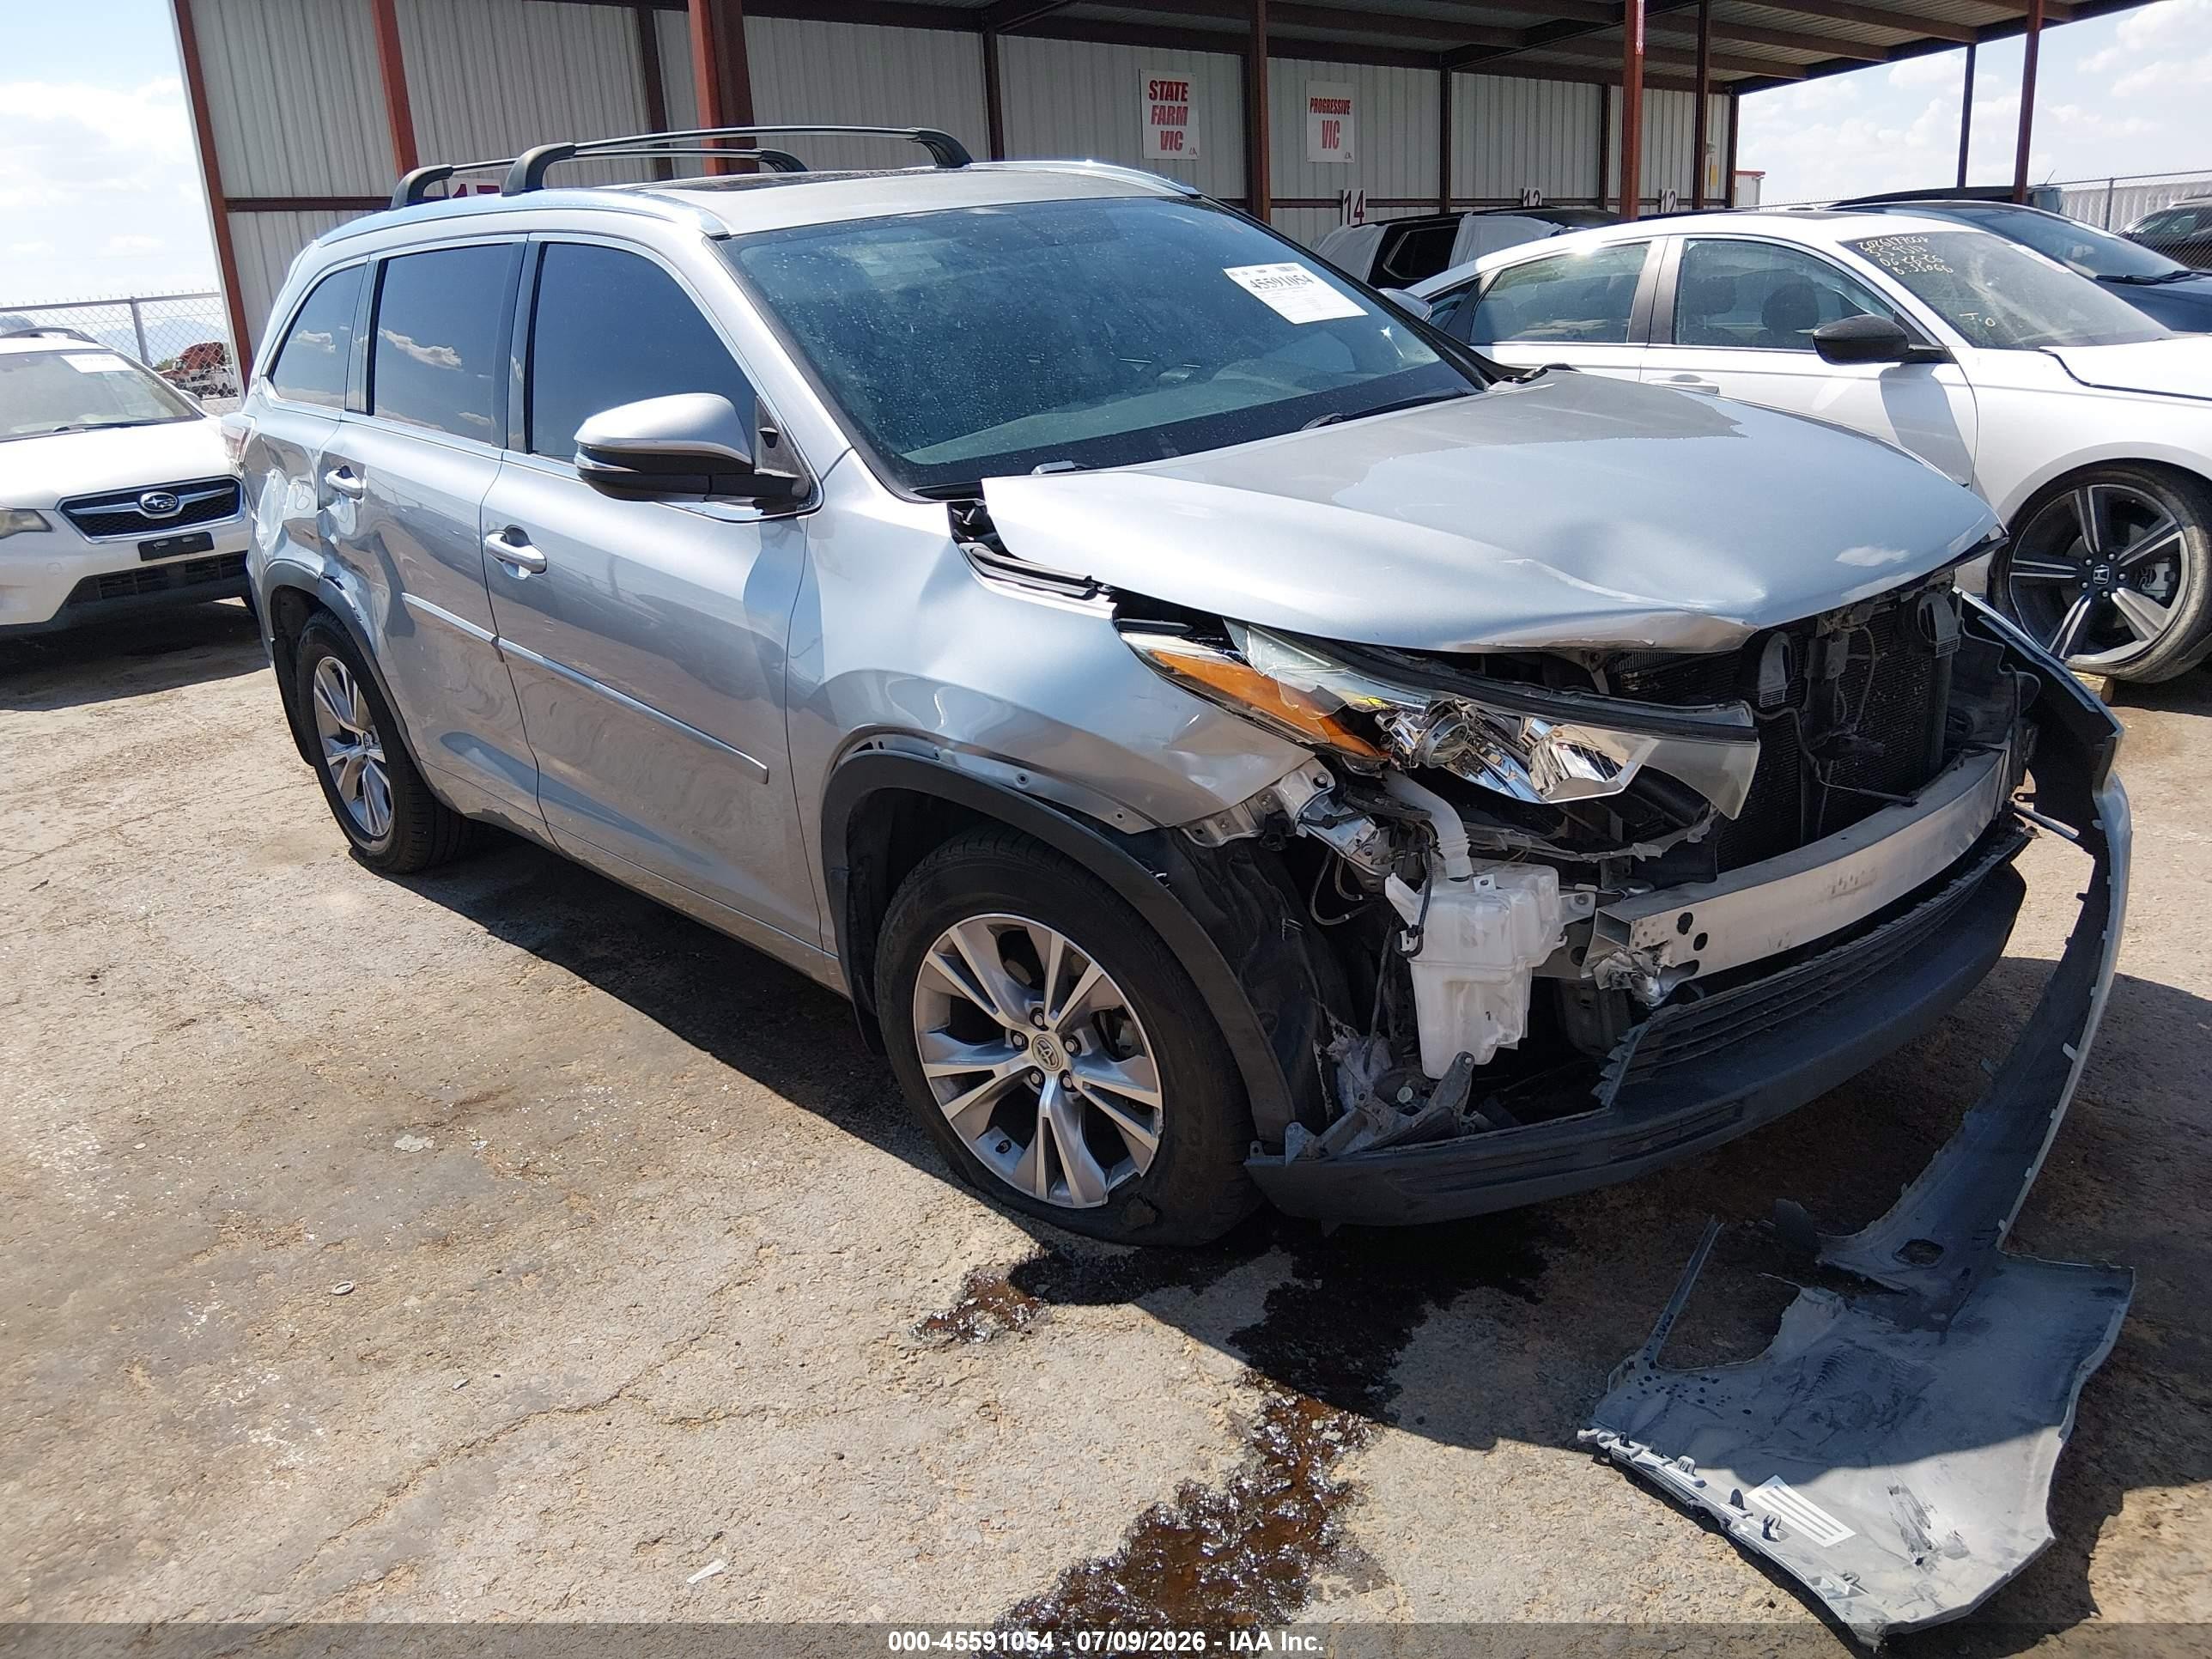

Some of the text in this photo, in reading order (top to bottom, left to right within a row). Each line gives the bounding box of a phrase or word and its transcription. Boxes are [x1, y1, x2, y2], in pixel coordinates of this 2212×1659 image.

[1148, 80, 1189, 102] STATE
[1151, 105, 1188, 126] FARM
[1310, 97, 1351, 115] PROGRESSIVE
[1160, 131, 1184, 151] VIC
[1322, 119, 1340, 149] VIC
[1344, 190, 1364, 225] 14
[1249, 275, 1315, 289] 45591054
